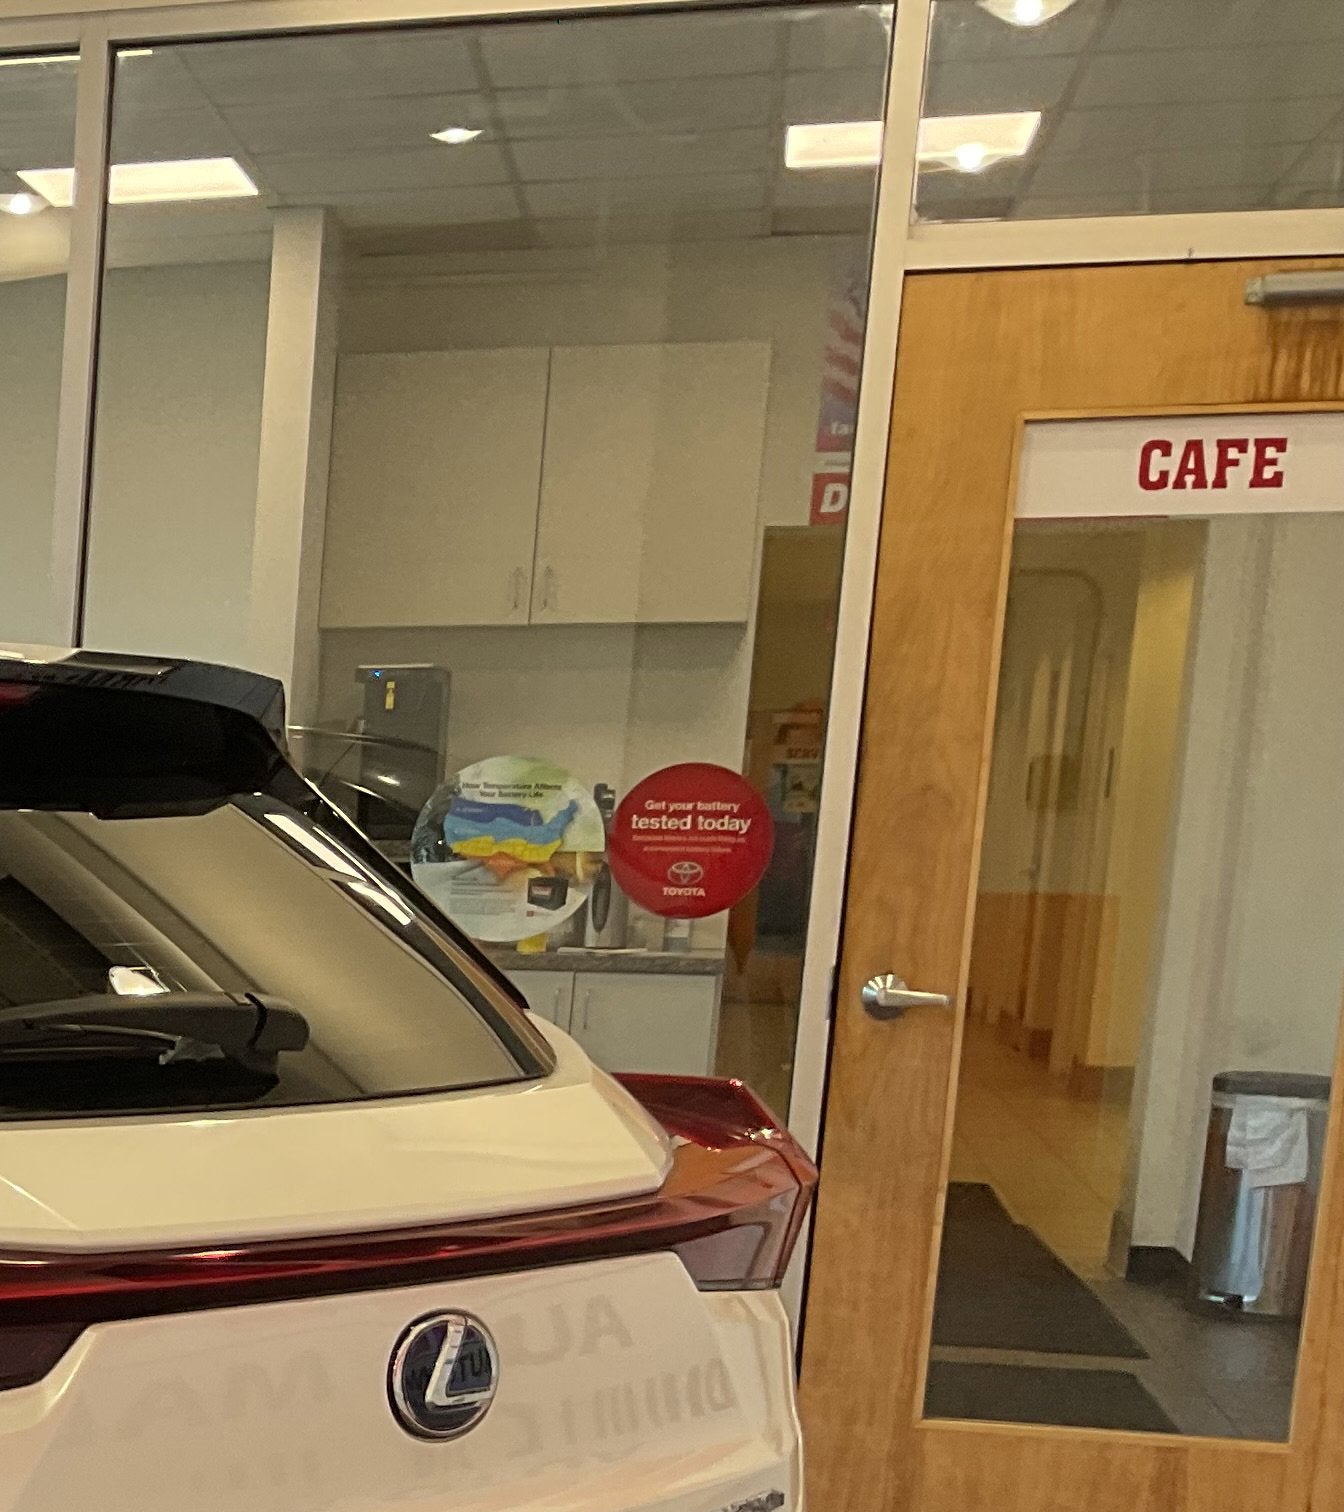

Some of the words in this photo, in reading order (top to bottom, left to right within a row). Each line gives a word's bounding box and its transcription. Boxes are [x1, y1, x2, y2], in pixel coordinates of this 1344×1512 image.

[1138, 437, 1288, 491] CAFE
[644, 800, 666, 811] Get
[668, 801, 695, 812] your
[697, 801, 740, 813] battery
[631, 814, 692, 830] tested
[697, 815, 751, 834] today
[663, 887, 706, 897] TOYOTA
